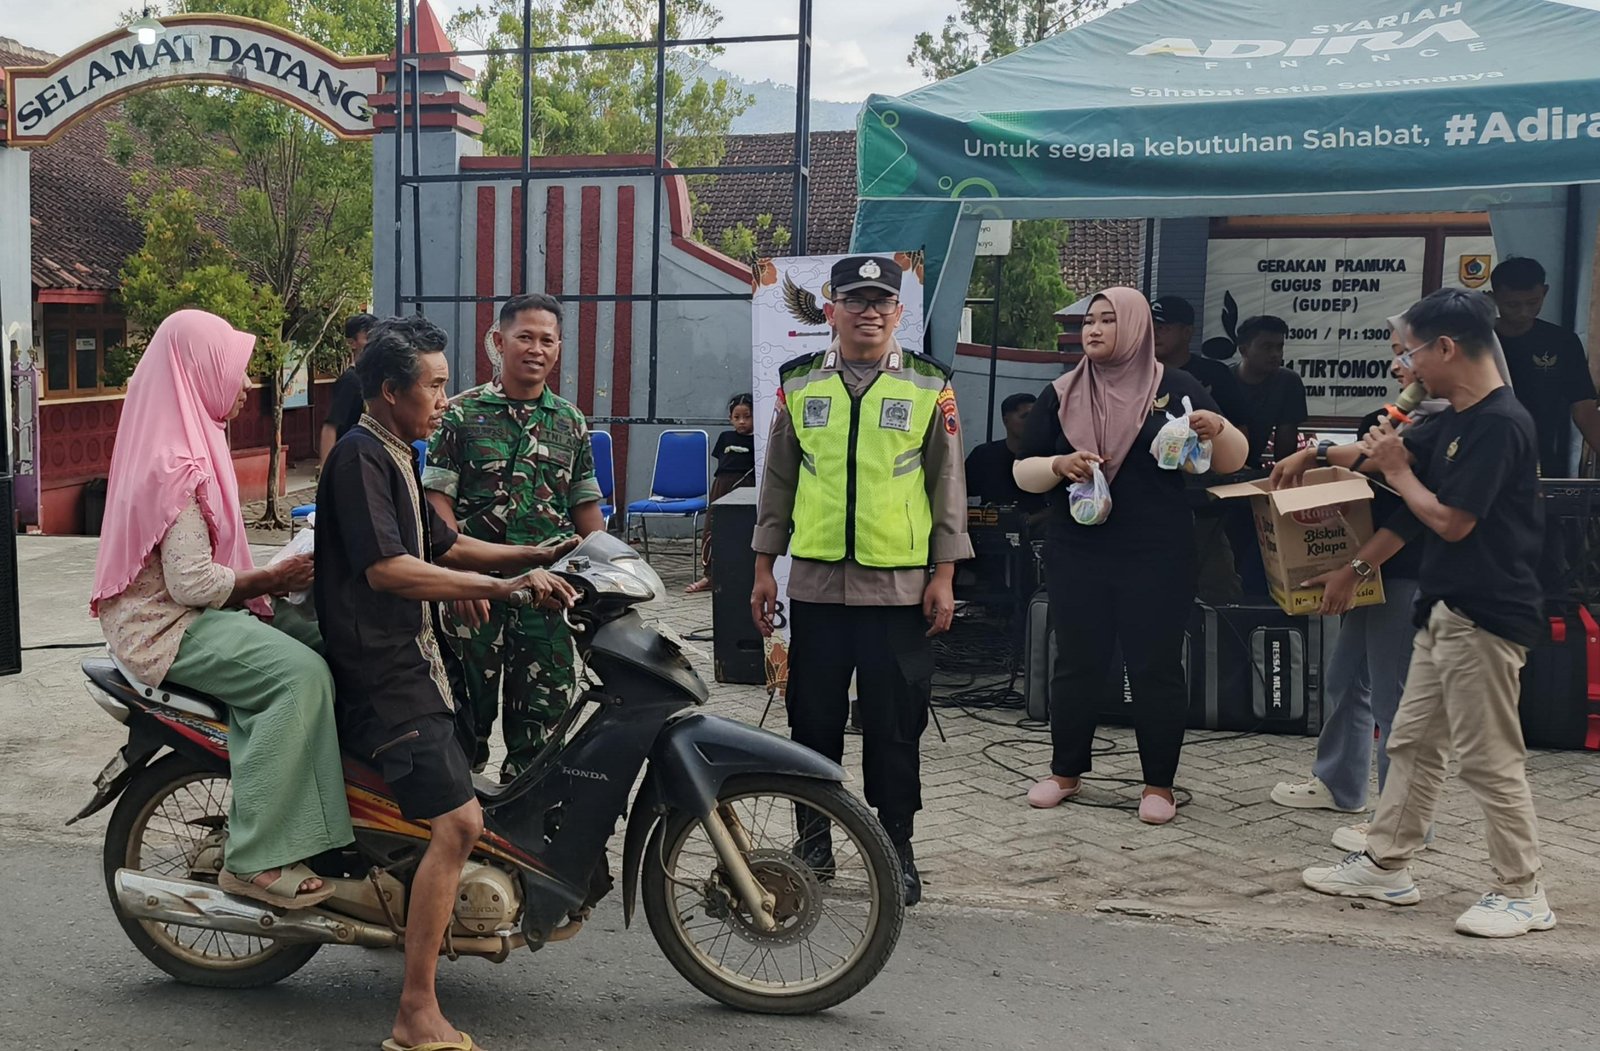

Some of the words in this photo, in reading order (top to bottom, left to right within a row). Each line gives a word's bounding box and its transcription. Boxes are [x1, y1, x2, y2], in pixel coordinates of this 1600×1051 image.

[1310, 1, 1463, 35] SYARIAH
[1127, 19, 1480, 59] ADIRA
[1205, 41, 1488, 70] FINANCE
[17, 34, 201, 131] SELAMAT
[208, 35, 373, 122] DATANG
[1129, 86, 1245, 98] Sahabat
[1254, 83, 1328, 95] Setia
[1337, 71, 1504, 90] Selamanya
[963, 138, 1040, 159] Untuk
[1048, 138, 1135, 162] segala
[1144, 131, 1293, 157] kebutuhan
[1303, 123, 1431, 149] Sahabat,
[1257, 259, 1326, 273] GERAKAN
[1335, 259, 1406, 273] PRAMUKA
[1271, 279, 1322, 292] GUGUS
[1332, 278, 1380, 292] DEPAN
[1293, 297, 1359, 313] (GUDEP)
[1298, 359, 1398, 379] TIRTOMOY
[1329, 385, 1387, 398] TIRTOMOYO
[1304, 527, 1347, 542] Biskuit
[1307, 541, 1347, 556] Kelapa
[1272, 640, 1281, 673] RESSA
[1273, 675, 1282, 708] MUSIC
[562, 766, 609, 781] HONDA
